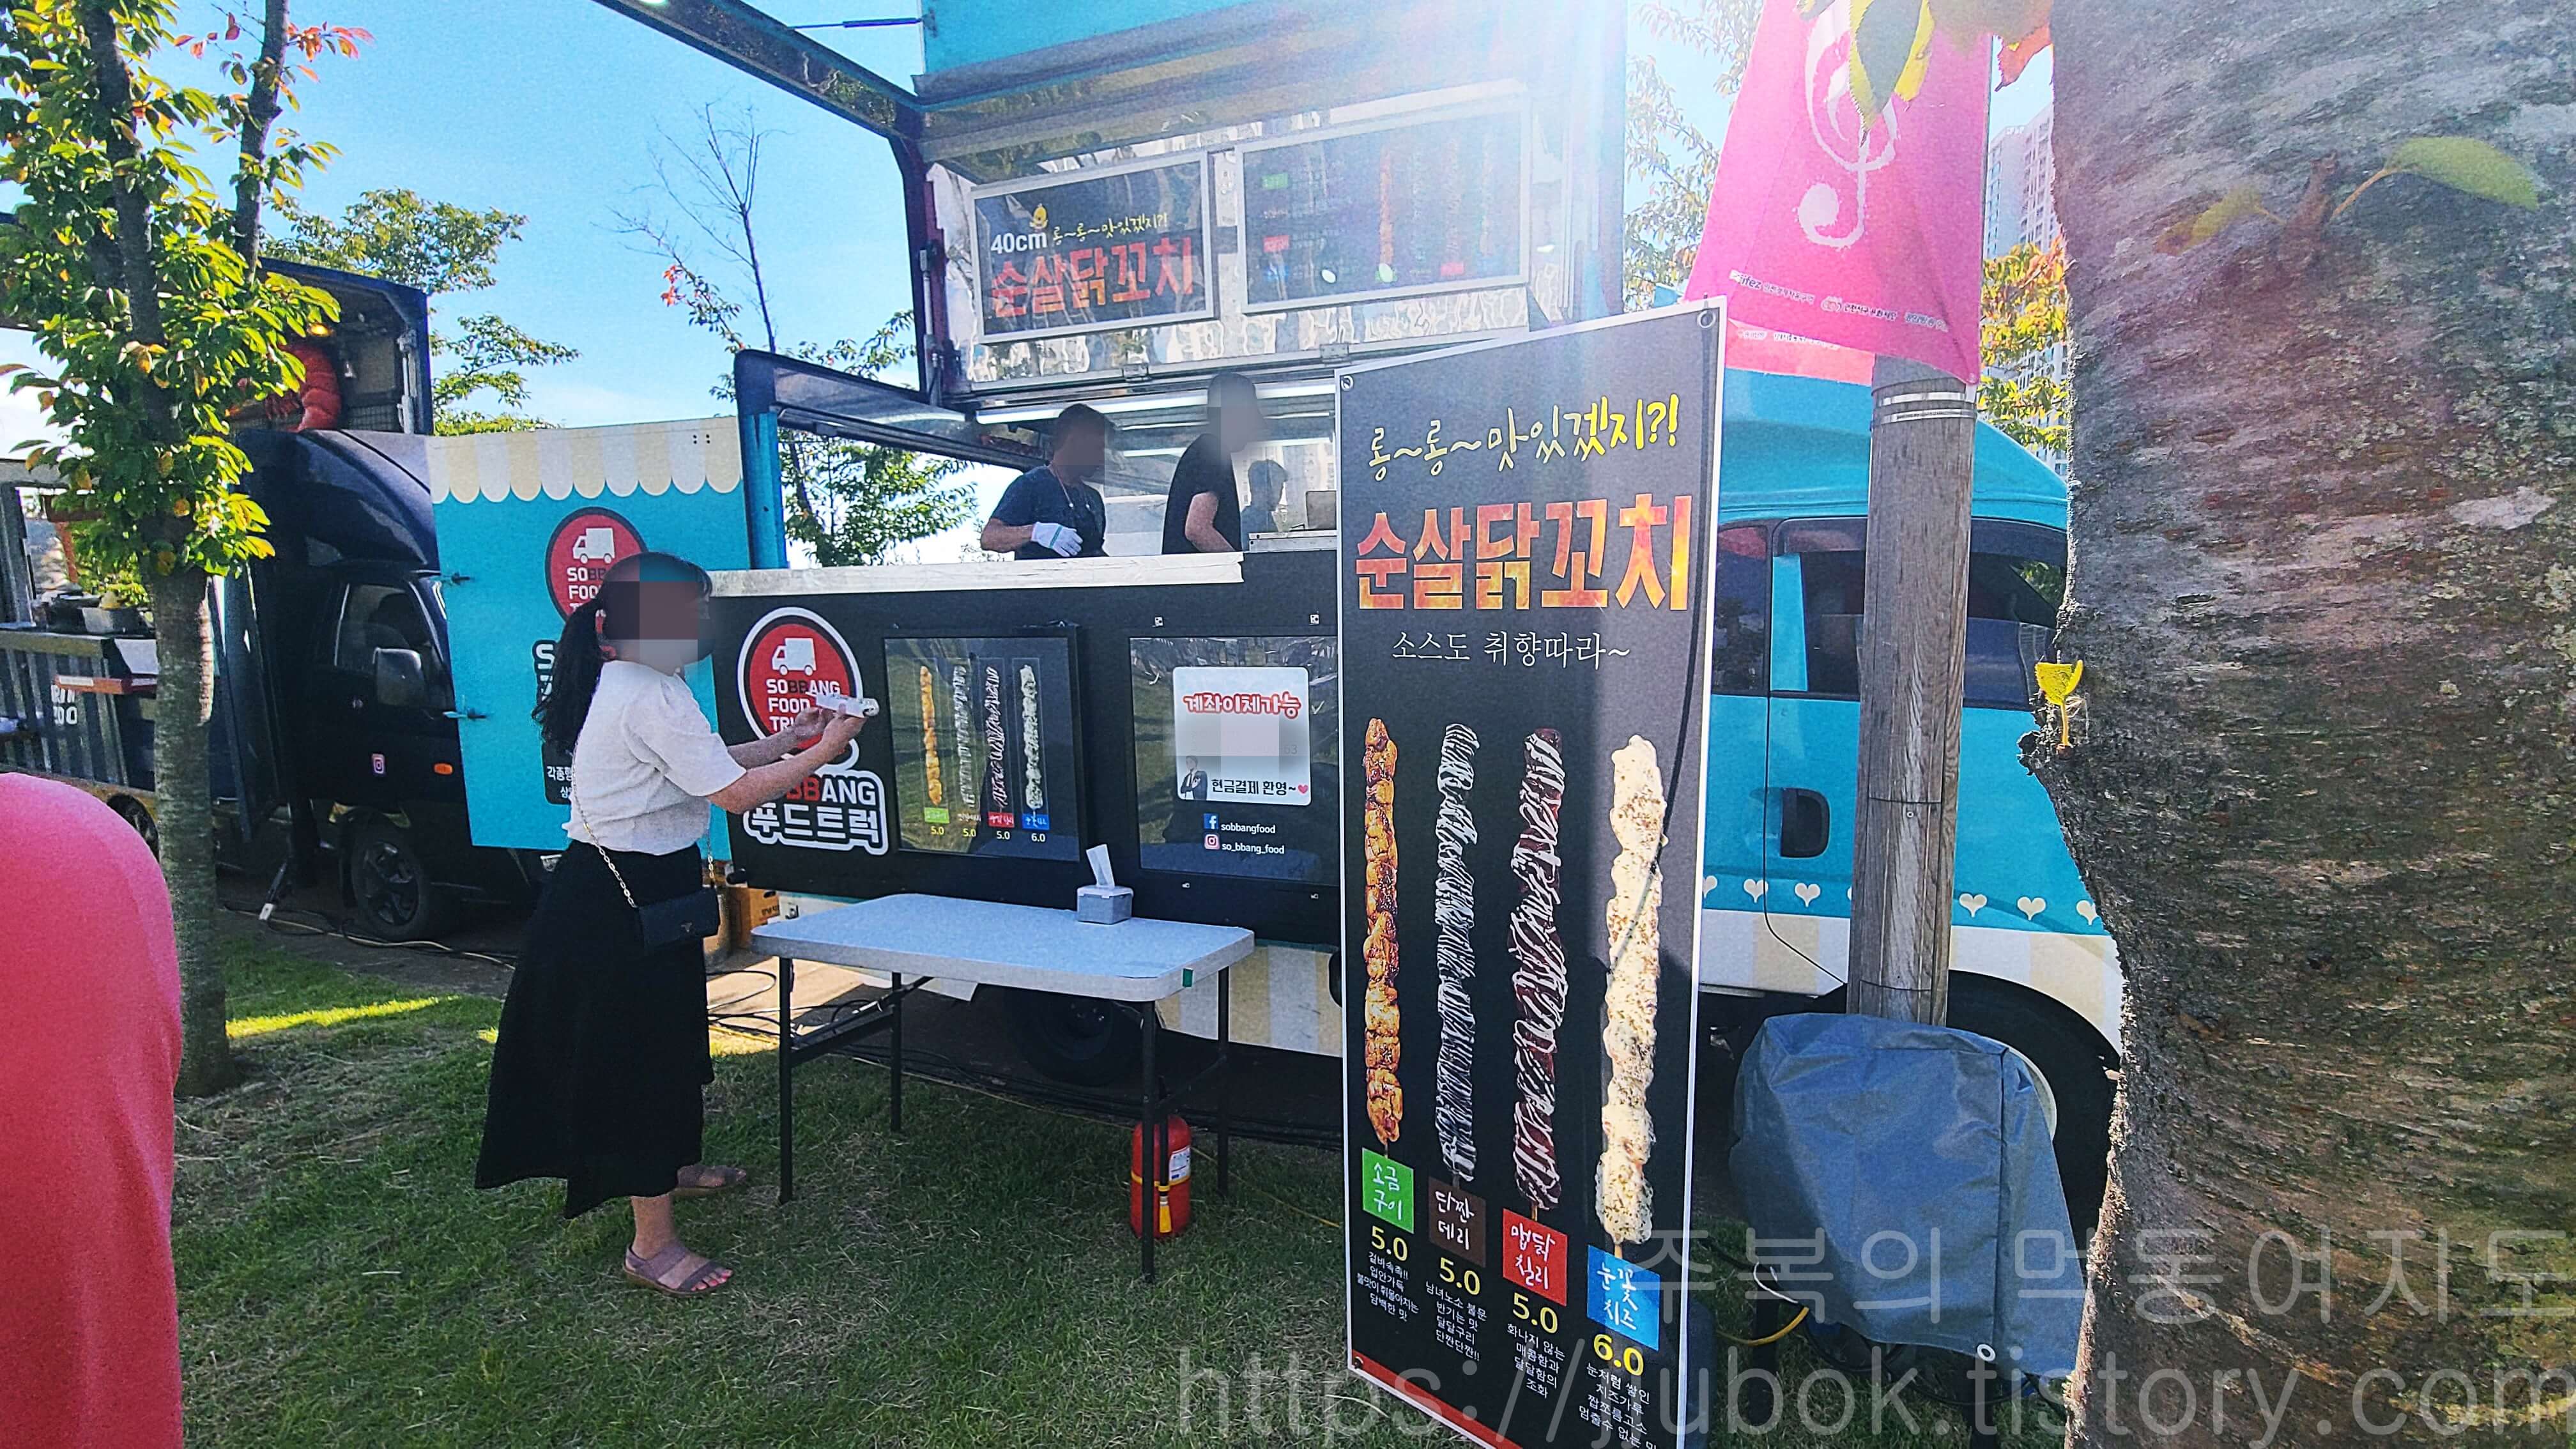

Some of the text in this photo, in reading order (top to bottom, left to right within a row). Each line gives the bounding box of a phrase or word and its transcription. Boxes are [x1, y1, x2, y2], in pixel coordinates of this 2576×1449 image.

[992, 232, 1048, 254] 40cm
[992, 236, 1194, 318] 순살닭꼬치
[1355, 493, 1692, 611] 순살닭꼬치
[568, 585, 601, 600] FOO
[1392, 631, 1631, 670] 소스도 취향따라~
[766, 678, 841, 695] SOBBANG
[769, 698, 811, 714] FOOD
[1183, 691, 1302, 719] 계좌이체가능
[1211, 778, 1296, 795] 현금결제 환영~
[751, 802, 880, 843] 푸드트럭
[931, 825, 1046, 842] 5.0 5.0 5.0 6.0
[1221, 822, 1276, 834] sobbangfood
[1222, 842, 1285, 854] so_bbang_food
[1372, 1162, 1400, 1191] 소금
[1374, 1189, 1402, 1220] 구이
[1435, 1191, 1475, 1223] 단짠
[1371, 1225, 1407, 1261] 5.0
[1438, 1220, 1469, 1250] 데리
[1510, 1222, 1556, 1261] 맵닭
[1439, 1257, 1480, 1295] 5.0
[1515, 1254, 1548, 1289] 칠리
[1597, 1262, 1639, 1310] 눈꽃
[1370, 1292, 1407, 1322] 담백한 맛
[1425, 1280, 1464, 1308] 남녀노소
[1436, 1301, 1478, 1332] 반기는 맛
[1512, 1292, 1558, 1333] 5.0
[1604, 1300, 1637, 1330] 치즈
[1436, 1330, 1480, 1361] 단짠단짠!!
[1507, 1323, 1566, 1361] 화나지 않는
[1593, 1333, 1644, 1376] 6.0
[1514, 1356, 1557, 1389] 달달함의
[1516, 1342, 1560, 1374] 매콤함과
[1526, 1378, 1548, 1399] 조화
[1586, 1362, 1621, 1390] 눈처럼
[1595, 1383, 1644, 1416] 치즈가루
[1618, 1426, 1641, 1448] 없는
